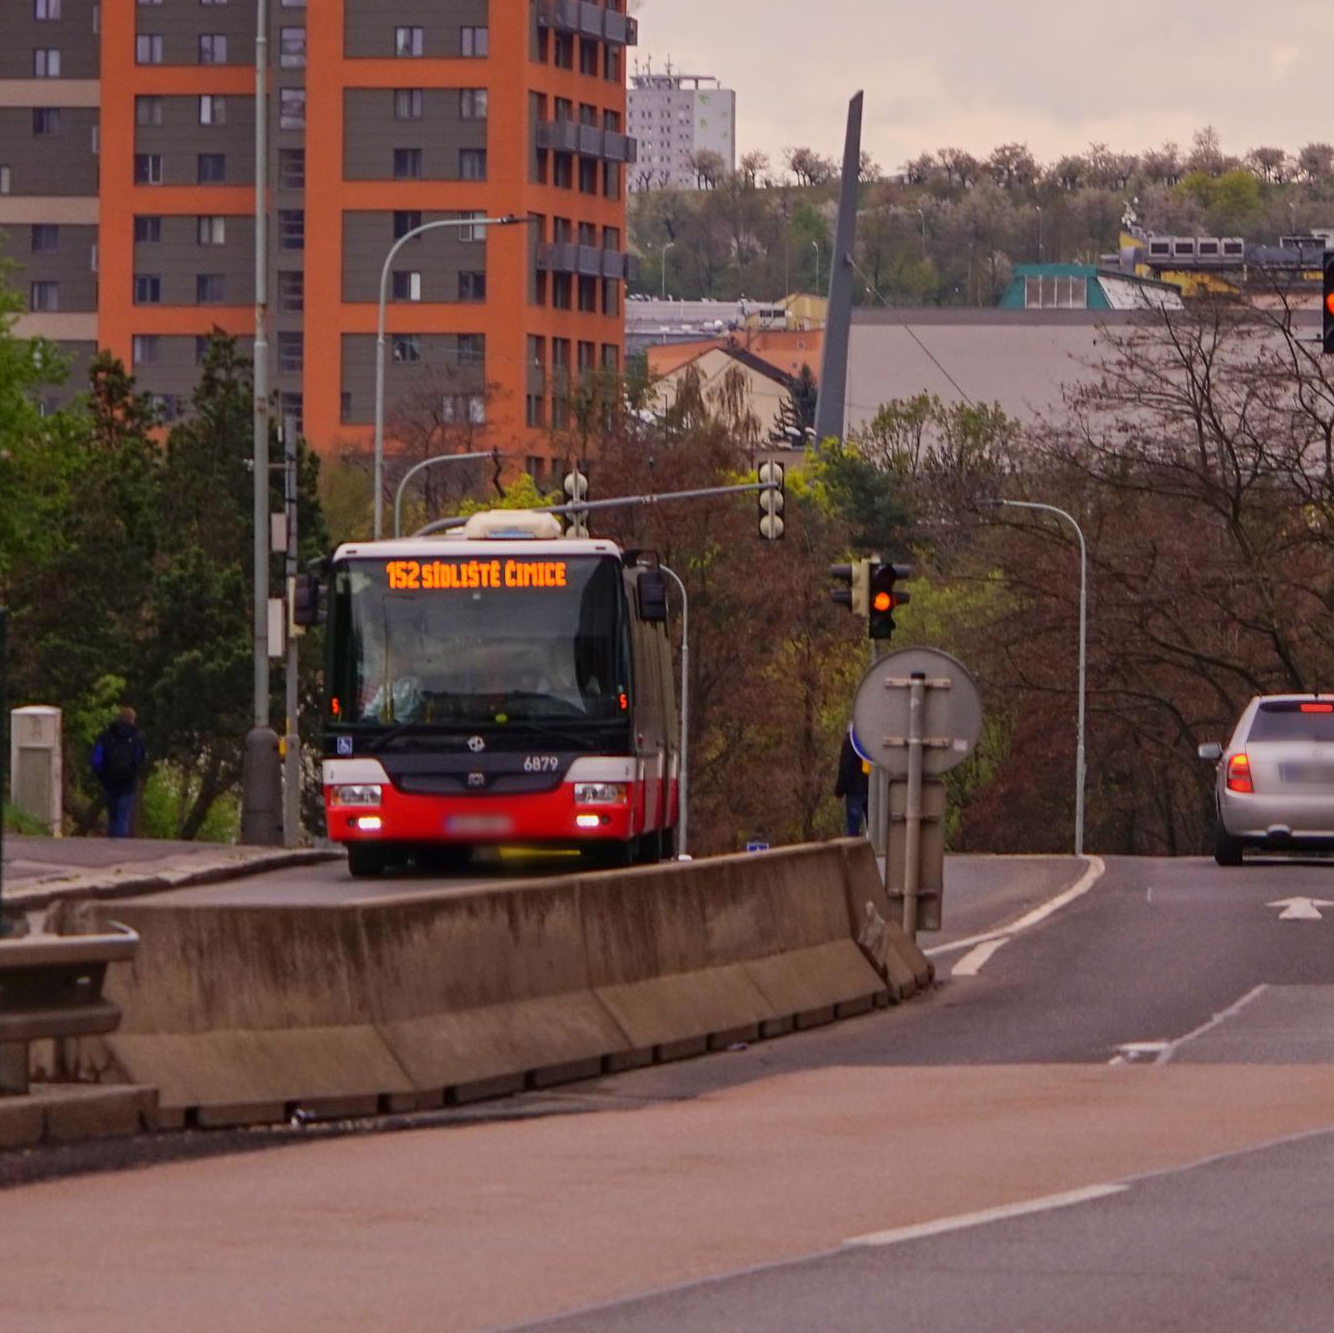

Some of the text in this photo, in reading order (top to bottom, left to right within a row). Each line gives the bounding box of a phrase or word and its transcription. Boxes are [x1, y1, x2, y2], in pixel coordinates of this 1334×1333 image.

[385, 560, 421, 589] 152
[504, 559, 567, 588] ČIMICE
[523, 755, 559, 772] 6879
